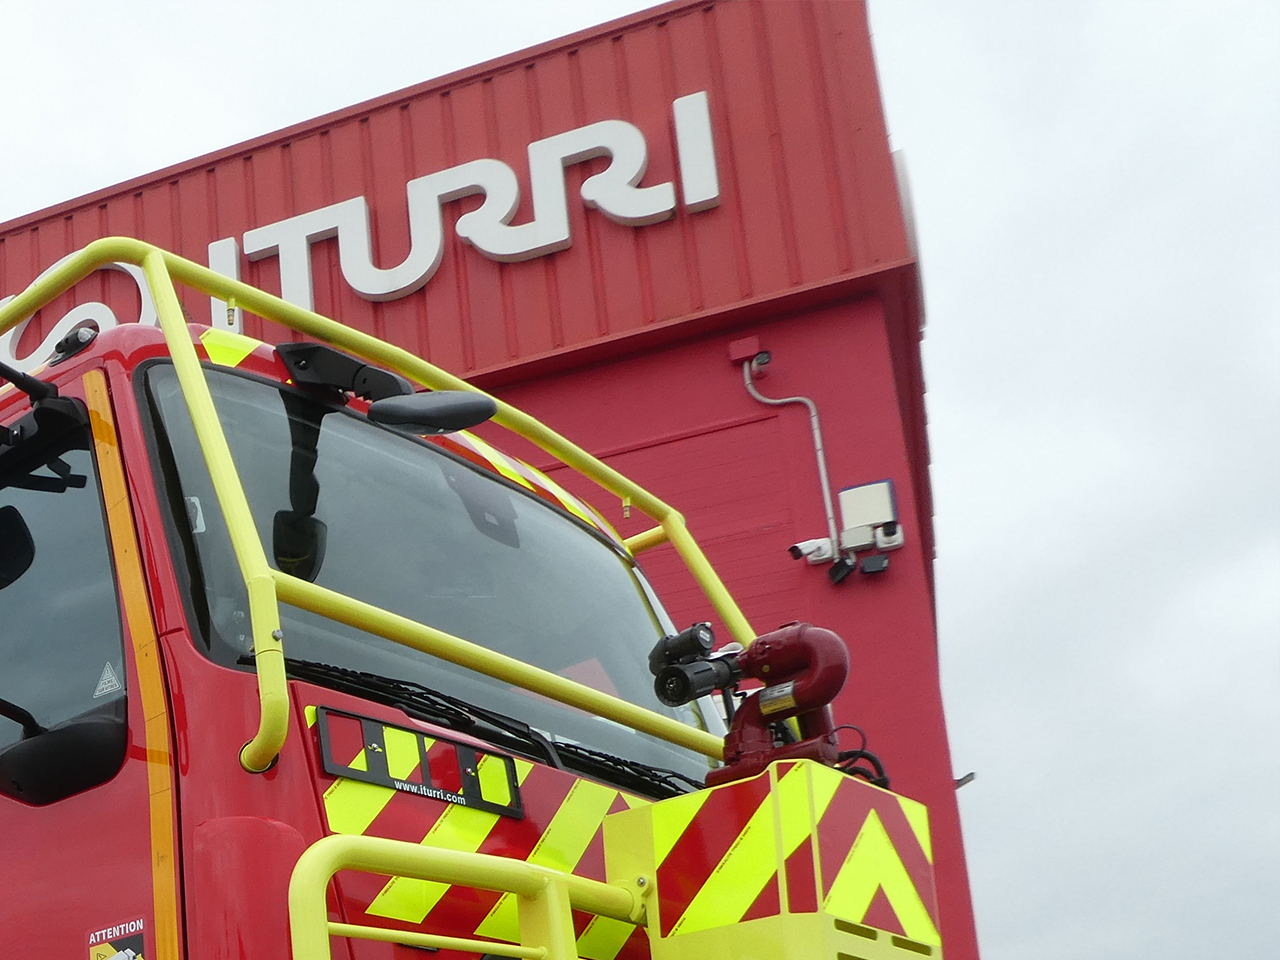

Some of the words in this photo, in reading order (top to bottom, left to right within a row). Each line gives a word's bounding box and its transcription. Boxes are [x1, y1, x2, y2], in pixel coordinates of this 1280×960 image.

[208, 91, 719, 333] ITURRI
[394, 781, 466, 805] www.iturri.com
[89, 919, 144, 944] ATTENTION
